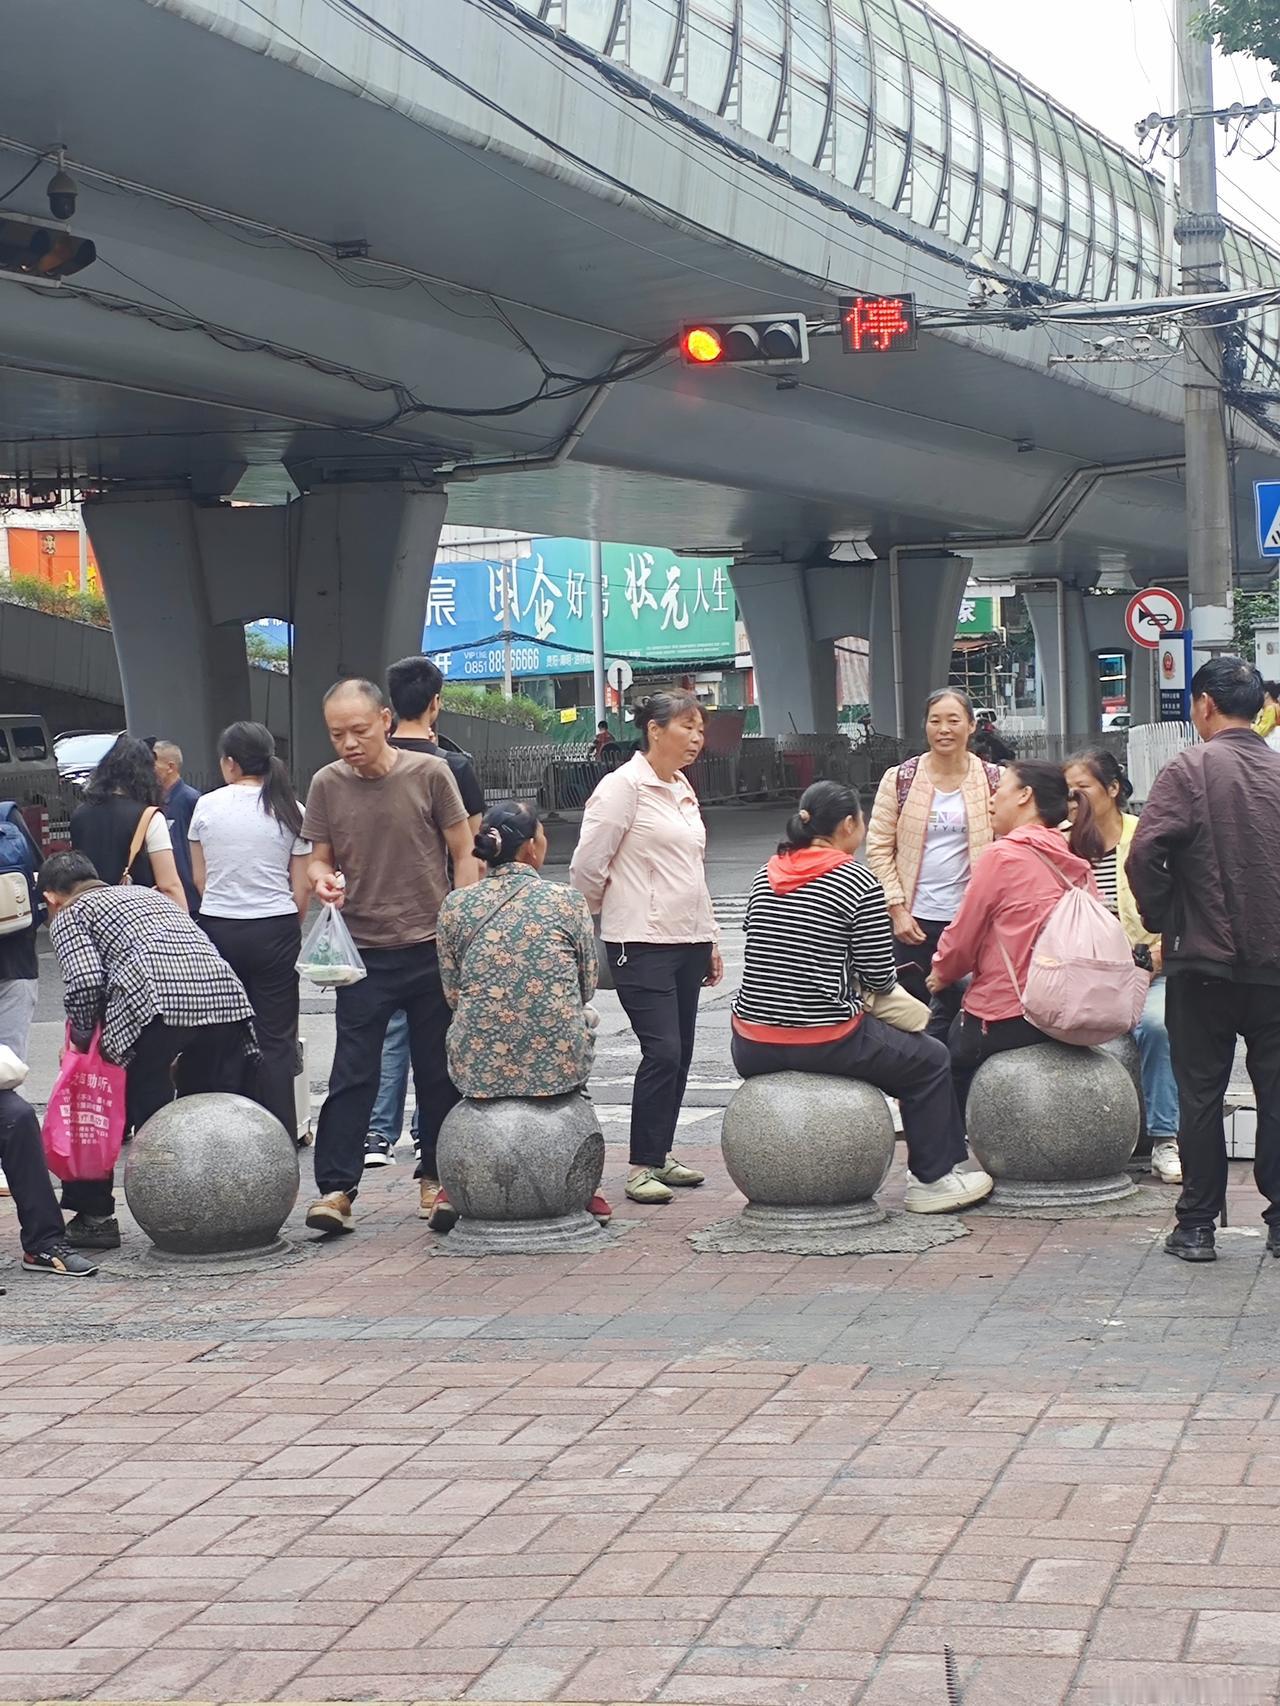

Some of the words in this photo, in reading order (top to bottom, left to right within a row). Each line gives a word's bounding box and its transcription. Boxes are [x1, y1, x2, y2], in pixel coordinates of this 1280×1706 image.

[846, 297, 908, 350] 停
[623, 552, 729, 630] 状元人生
[464, 660, 488, 674] 0851
